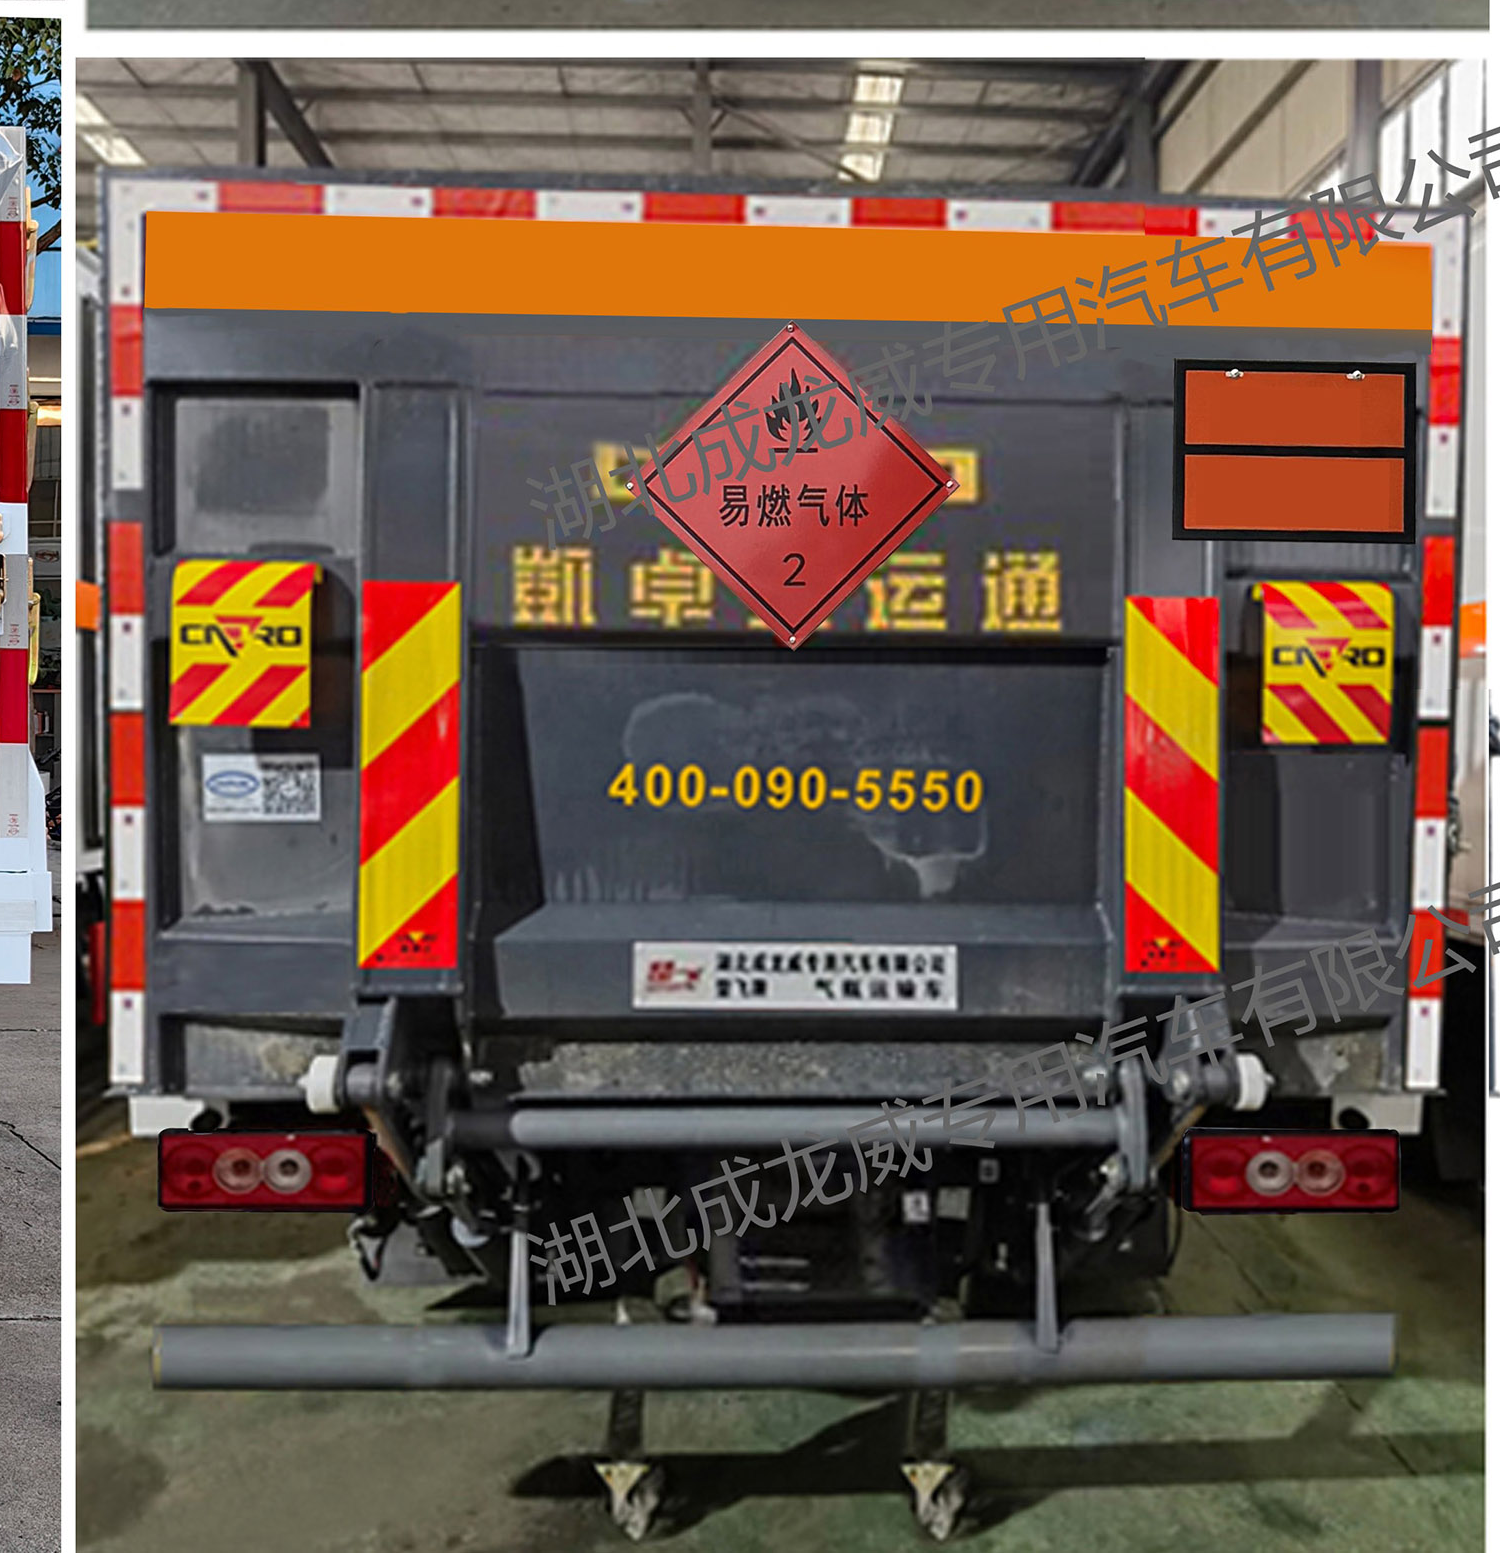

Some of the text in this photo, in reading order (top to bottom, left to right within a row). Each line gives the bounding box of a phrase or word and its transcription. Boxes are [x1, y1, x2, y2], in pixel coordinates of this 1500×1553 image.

[718, 482, 870, 529] 易燃气体
[782, 552, 807, 587] 2
[607, 762, 984, 813] 400-090-5550
